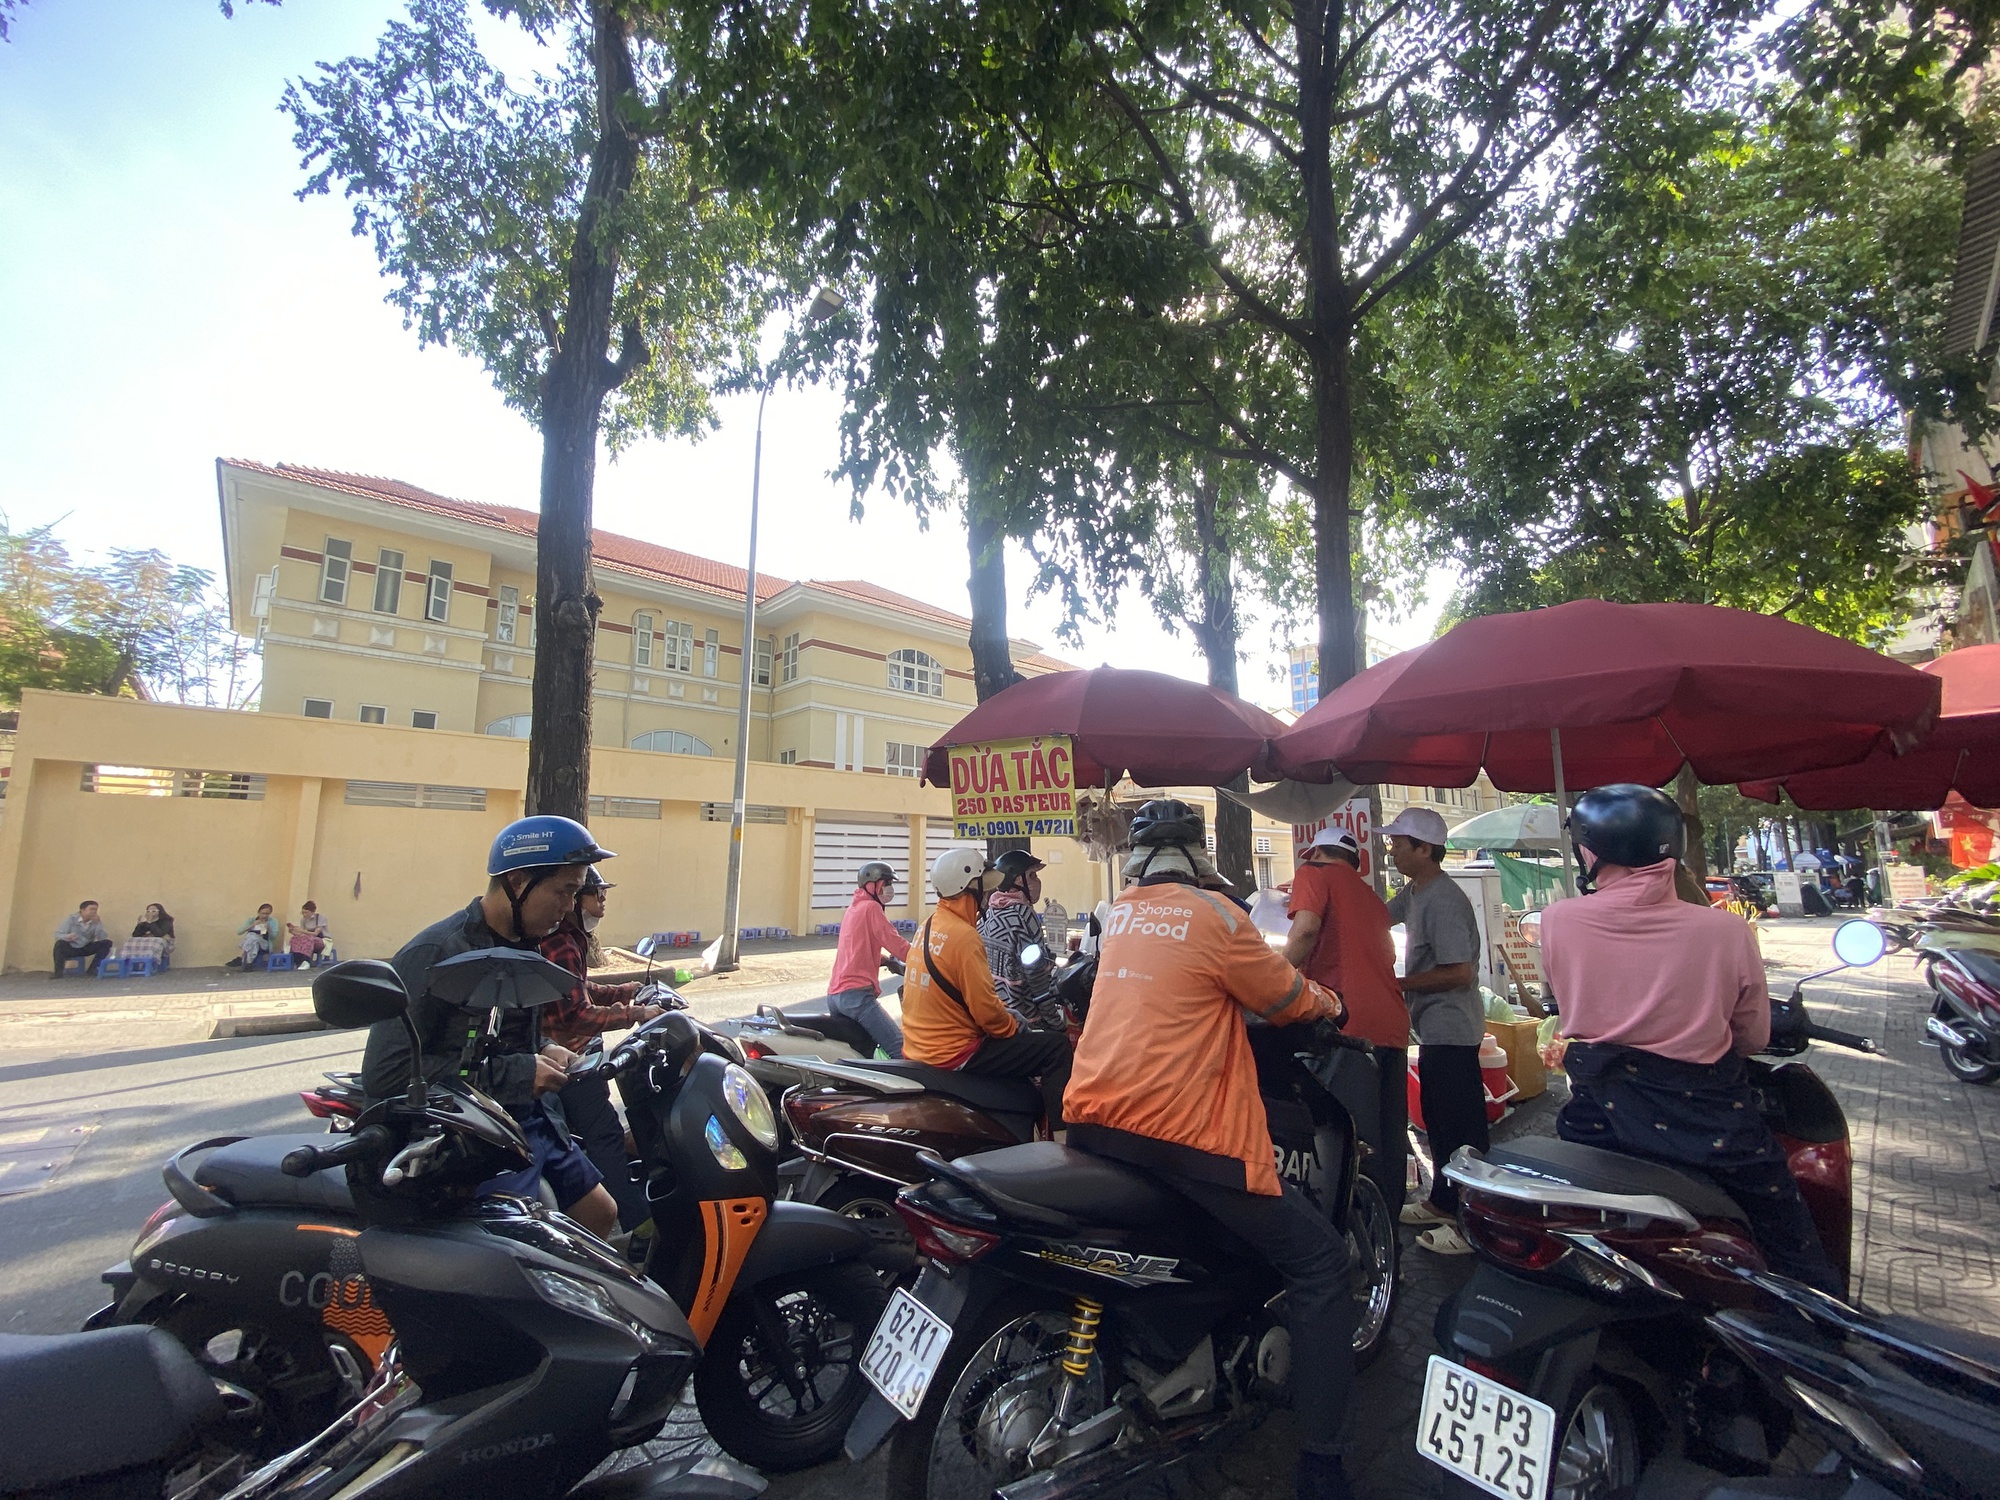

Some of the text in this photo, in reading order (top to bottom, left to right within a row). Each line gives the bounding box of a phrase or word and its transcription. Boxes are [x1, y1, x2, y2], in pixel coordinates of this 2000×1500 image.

[952, 737, 1070, 795] DỪA TẮC
[957, 792, 1071, 815] 250 PASTEUR
[516, 832, 540, 841] Smile
[1136, 902, 1193, 918] Shopee
[1128, 917, 1189, 941] Food
[852, 1123, 921, 1136] LEAD
[150, 1258, 240, 1285] SCOOPY
[1476, 1294, 1524, 1318] HONDA
[1443, 1370, 1532, 1448] 59-P3
[460, 1432, 556, 1466] HONDA
[1428, 1412, 1537, 1500] 451.25
